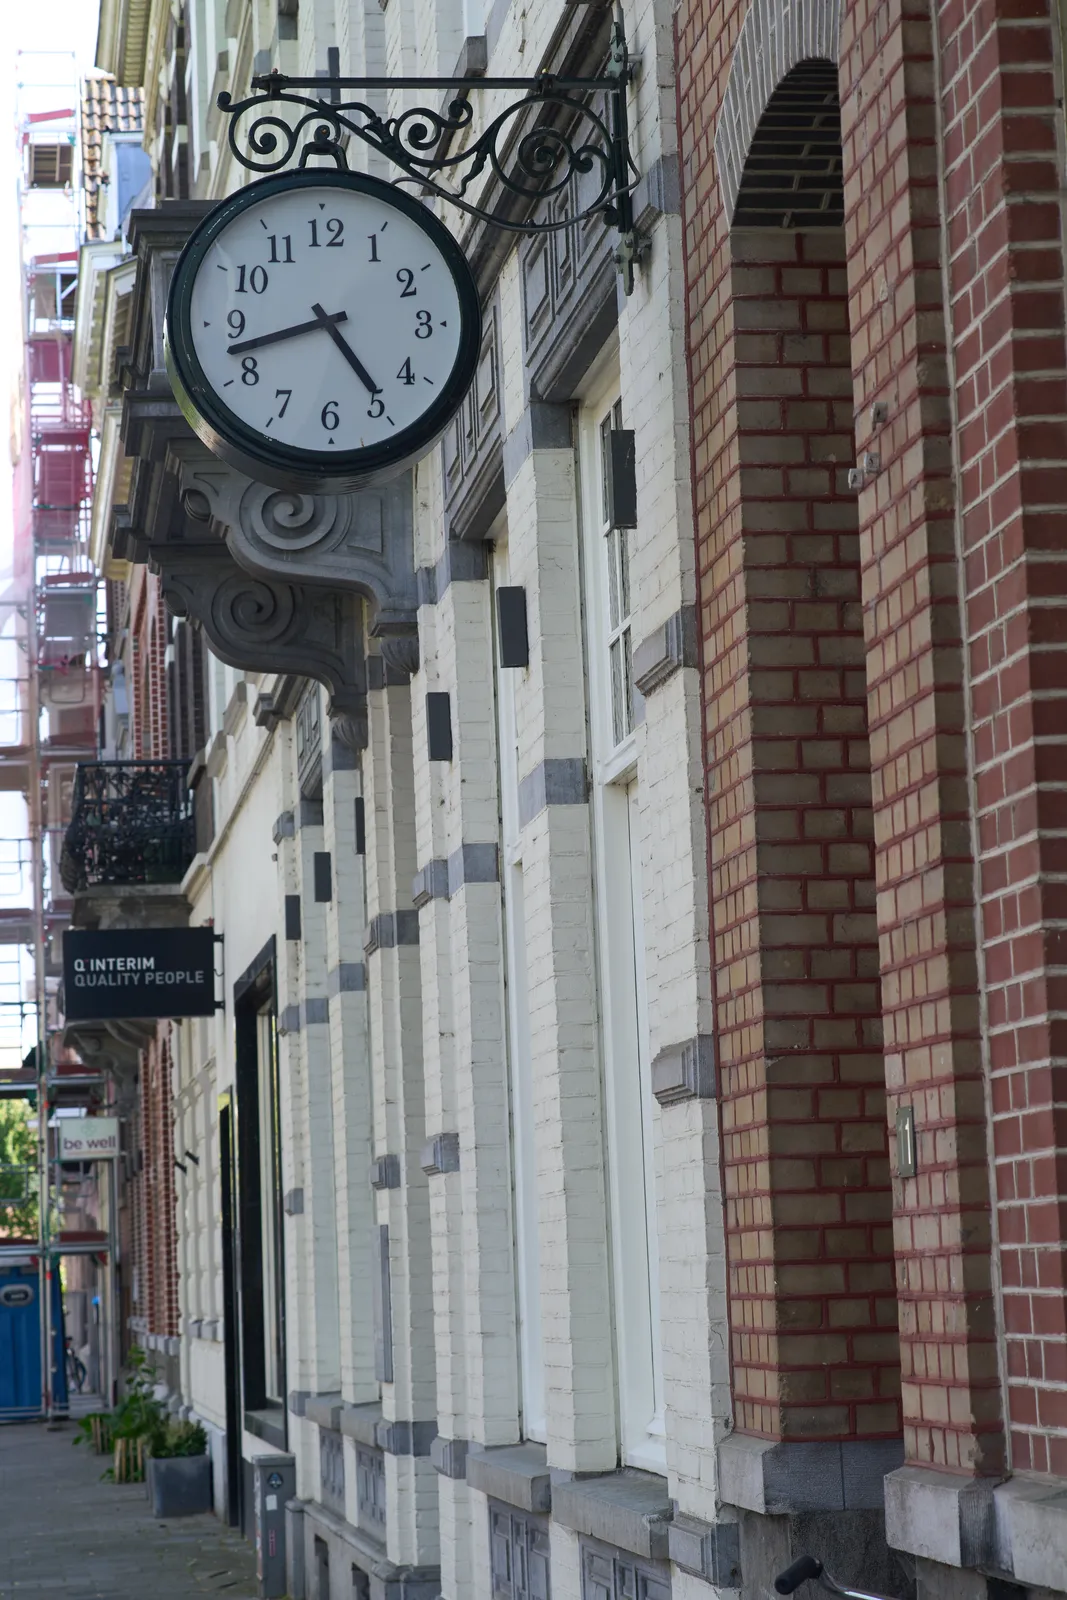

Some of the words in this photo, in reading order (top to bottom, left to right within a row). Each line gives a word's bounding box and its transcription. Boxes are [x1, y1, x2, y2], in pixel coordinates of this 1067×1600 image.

[308, 218, 345, 247] 12
[267, 234, 296, 263] 11
[367, 234, 381, 262] 1
[235, 265, 269, 294] 10
[396, 268, 417, 298] 2
[227, 309, 246, 339] 9
[414, 310, 433, 339] 3
[241, 357, 260, 386] 8
[396, 356, 415, 385] 4
[275, 389, 292, 418] 7
[321, 401, 340, 430] 6
[367, 388, 385, 418] 5
[74, 973, 140, 987] QUALITY
[145, 970, 204, 985] PEOPLE
[90, 957, 155, 971] INTERIM
[63, 1137, 83, 1150] be
[86, 1135, 117, 1149] well
